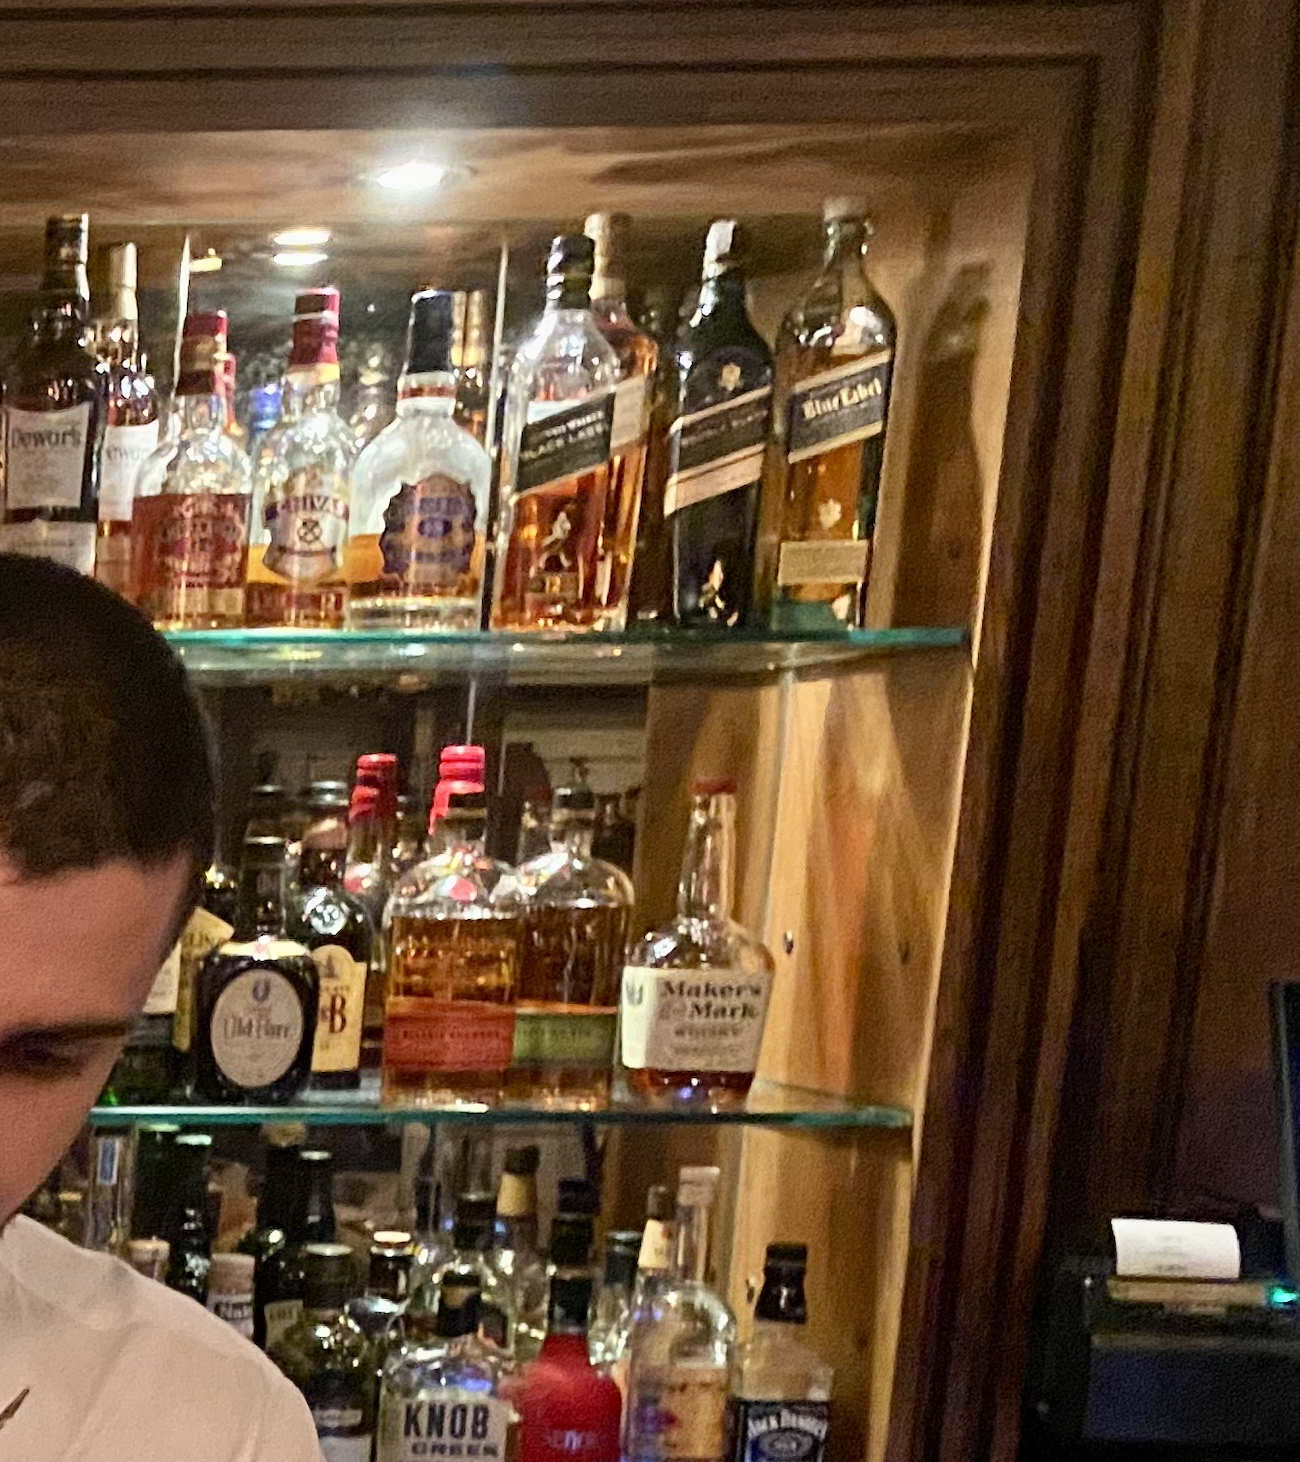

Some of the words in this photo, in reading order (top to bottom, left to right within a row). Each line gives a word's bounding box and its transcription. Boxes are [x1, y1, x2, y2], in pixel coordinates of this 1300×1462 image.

[803, 395, 840, 419] Blue
[839, 377, 883, 407] Label
[689, 1001, 759, 1020] Mark
[403, 1403, 490, 1440] KNOB
